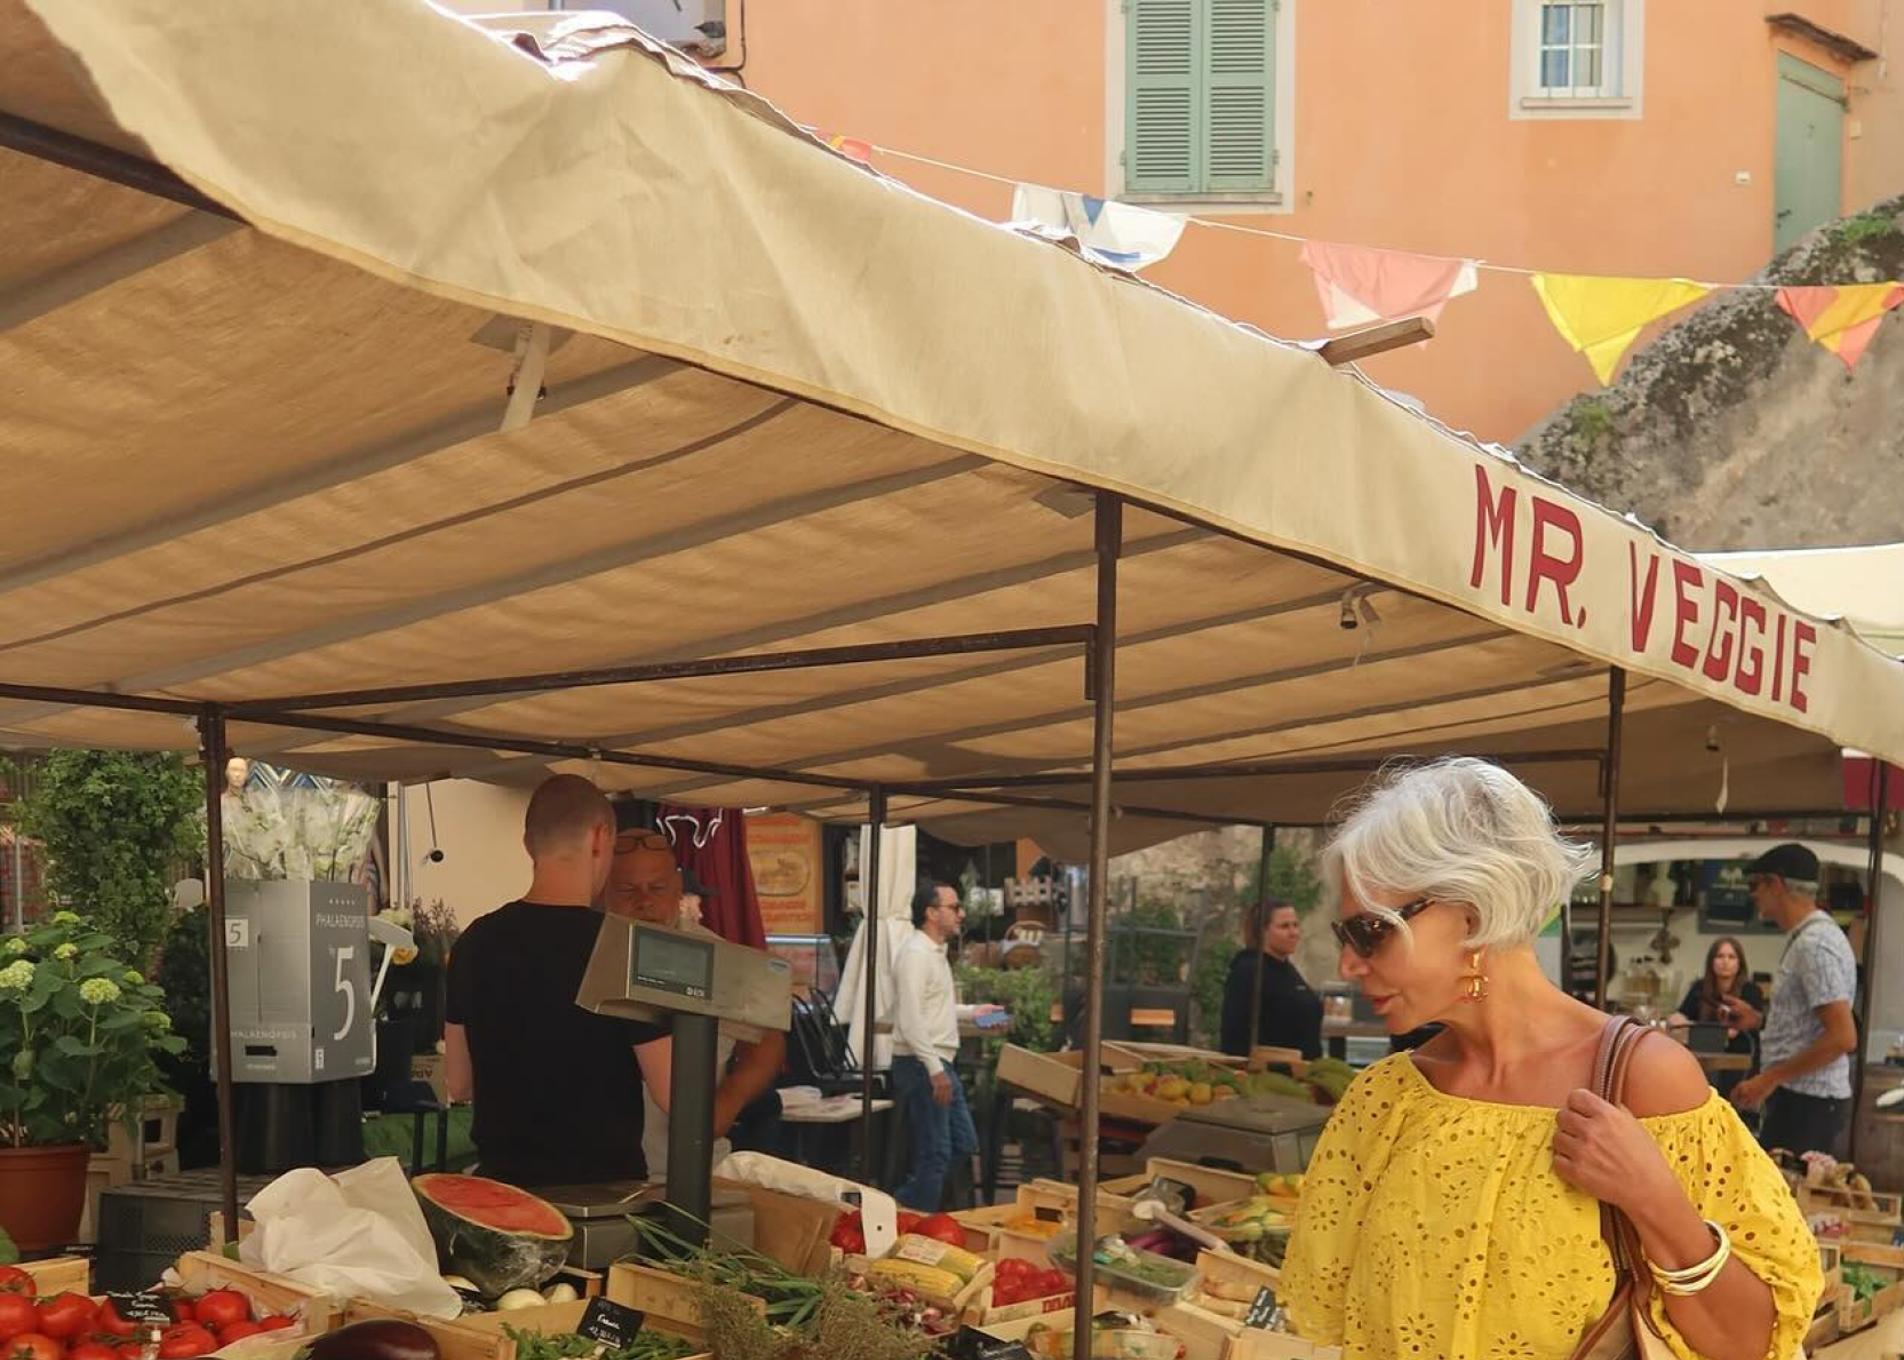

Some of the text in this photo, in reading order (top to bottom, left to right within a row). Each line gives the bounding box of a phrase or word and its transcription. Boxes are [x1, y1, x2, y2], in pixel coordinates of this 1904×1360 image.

[1470, 464, 1817, 713] MR. VEGGIE
[228, 923, 241, 944] 5
[333, 948, 355, 1041] 5
